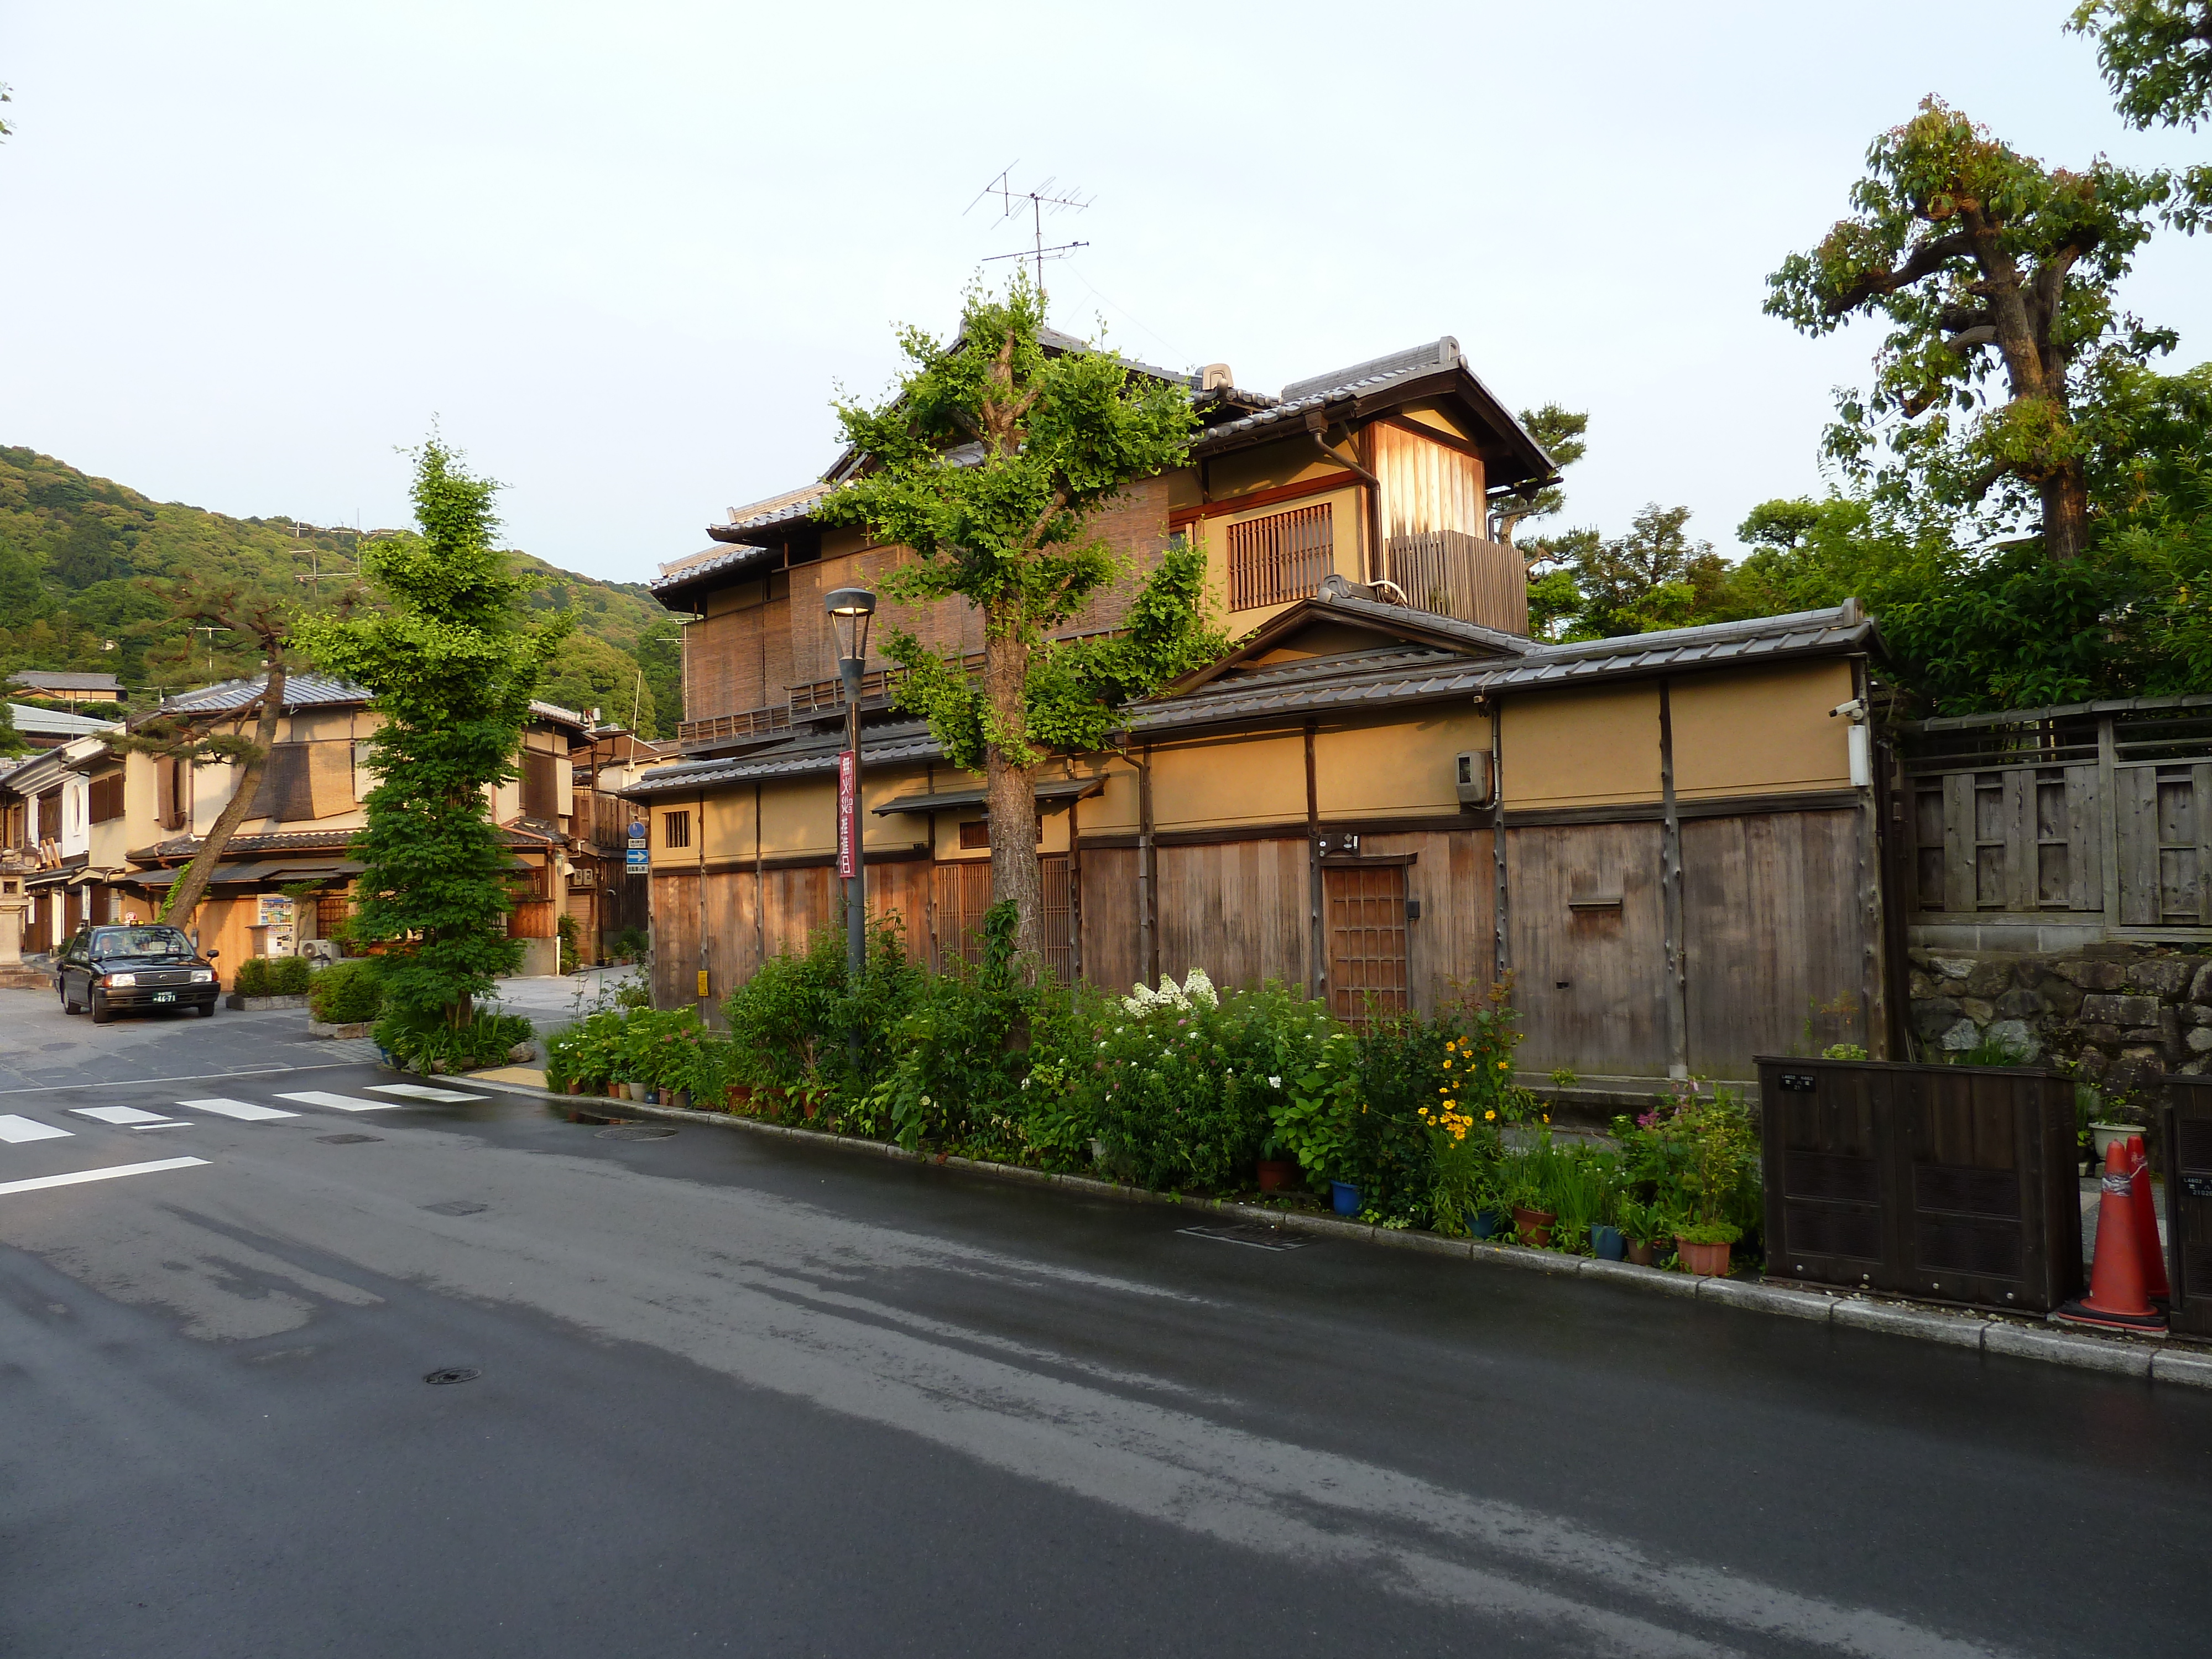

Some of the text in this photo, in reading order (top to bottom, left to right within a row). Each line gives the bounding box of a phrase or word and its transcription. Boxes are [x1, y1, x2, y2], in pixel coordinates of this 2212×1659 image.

[841, 757, 851, 874] 無火災推進日
